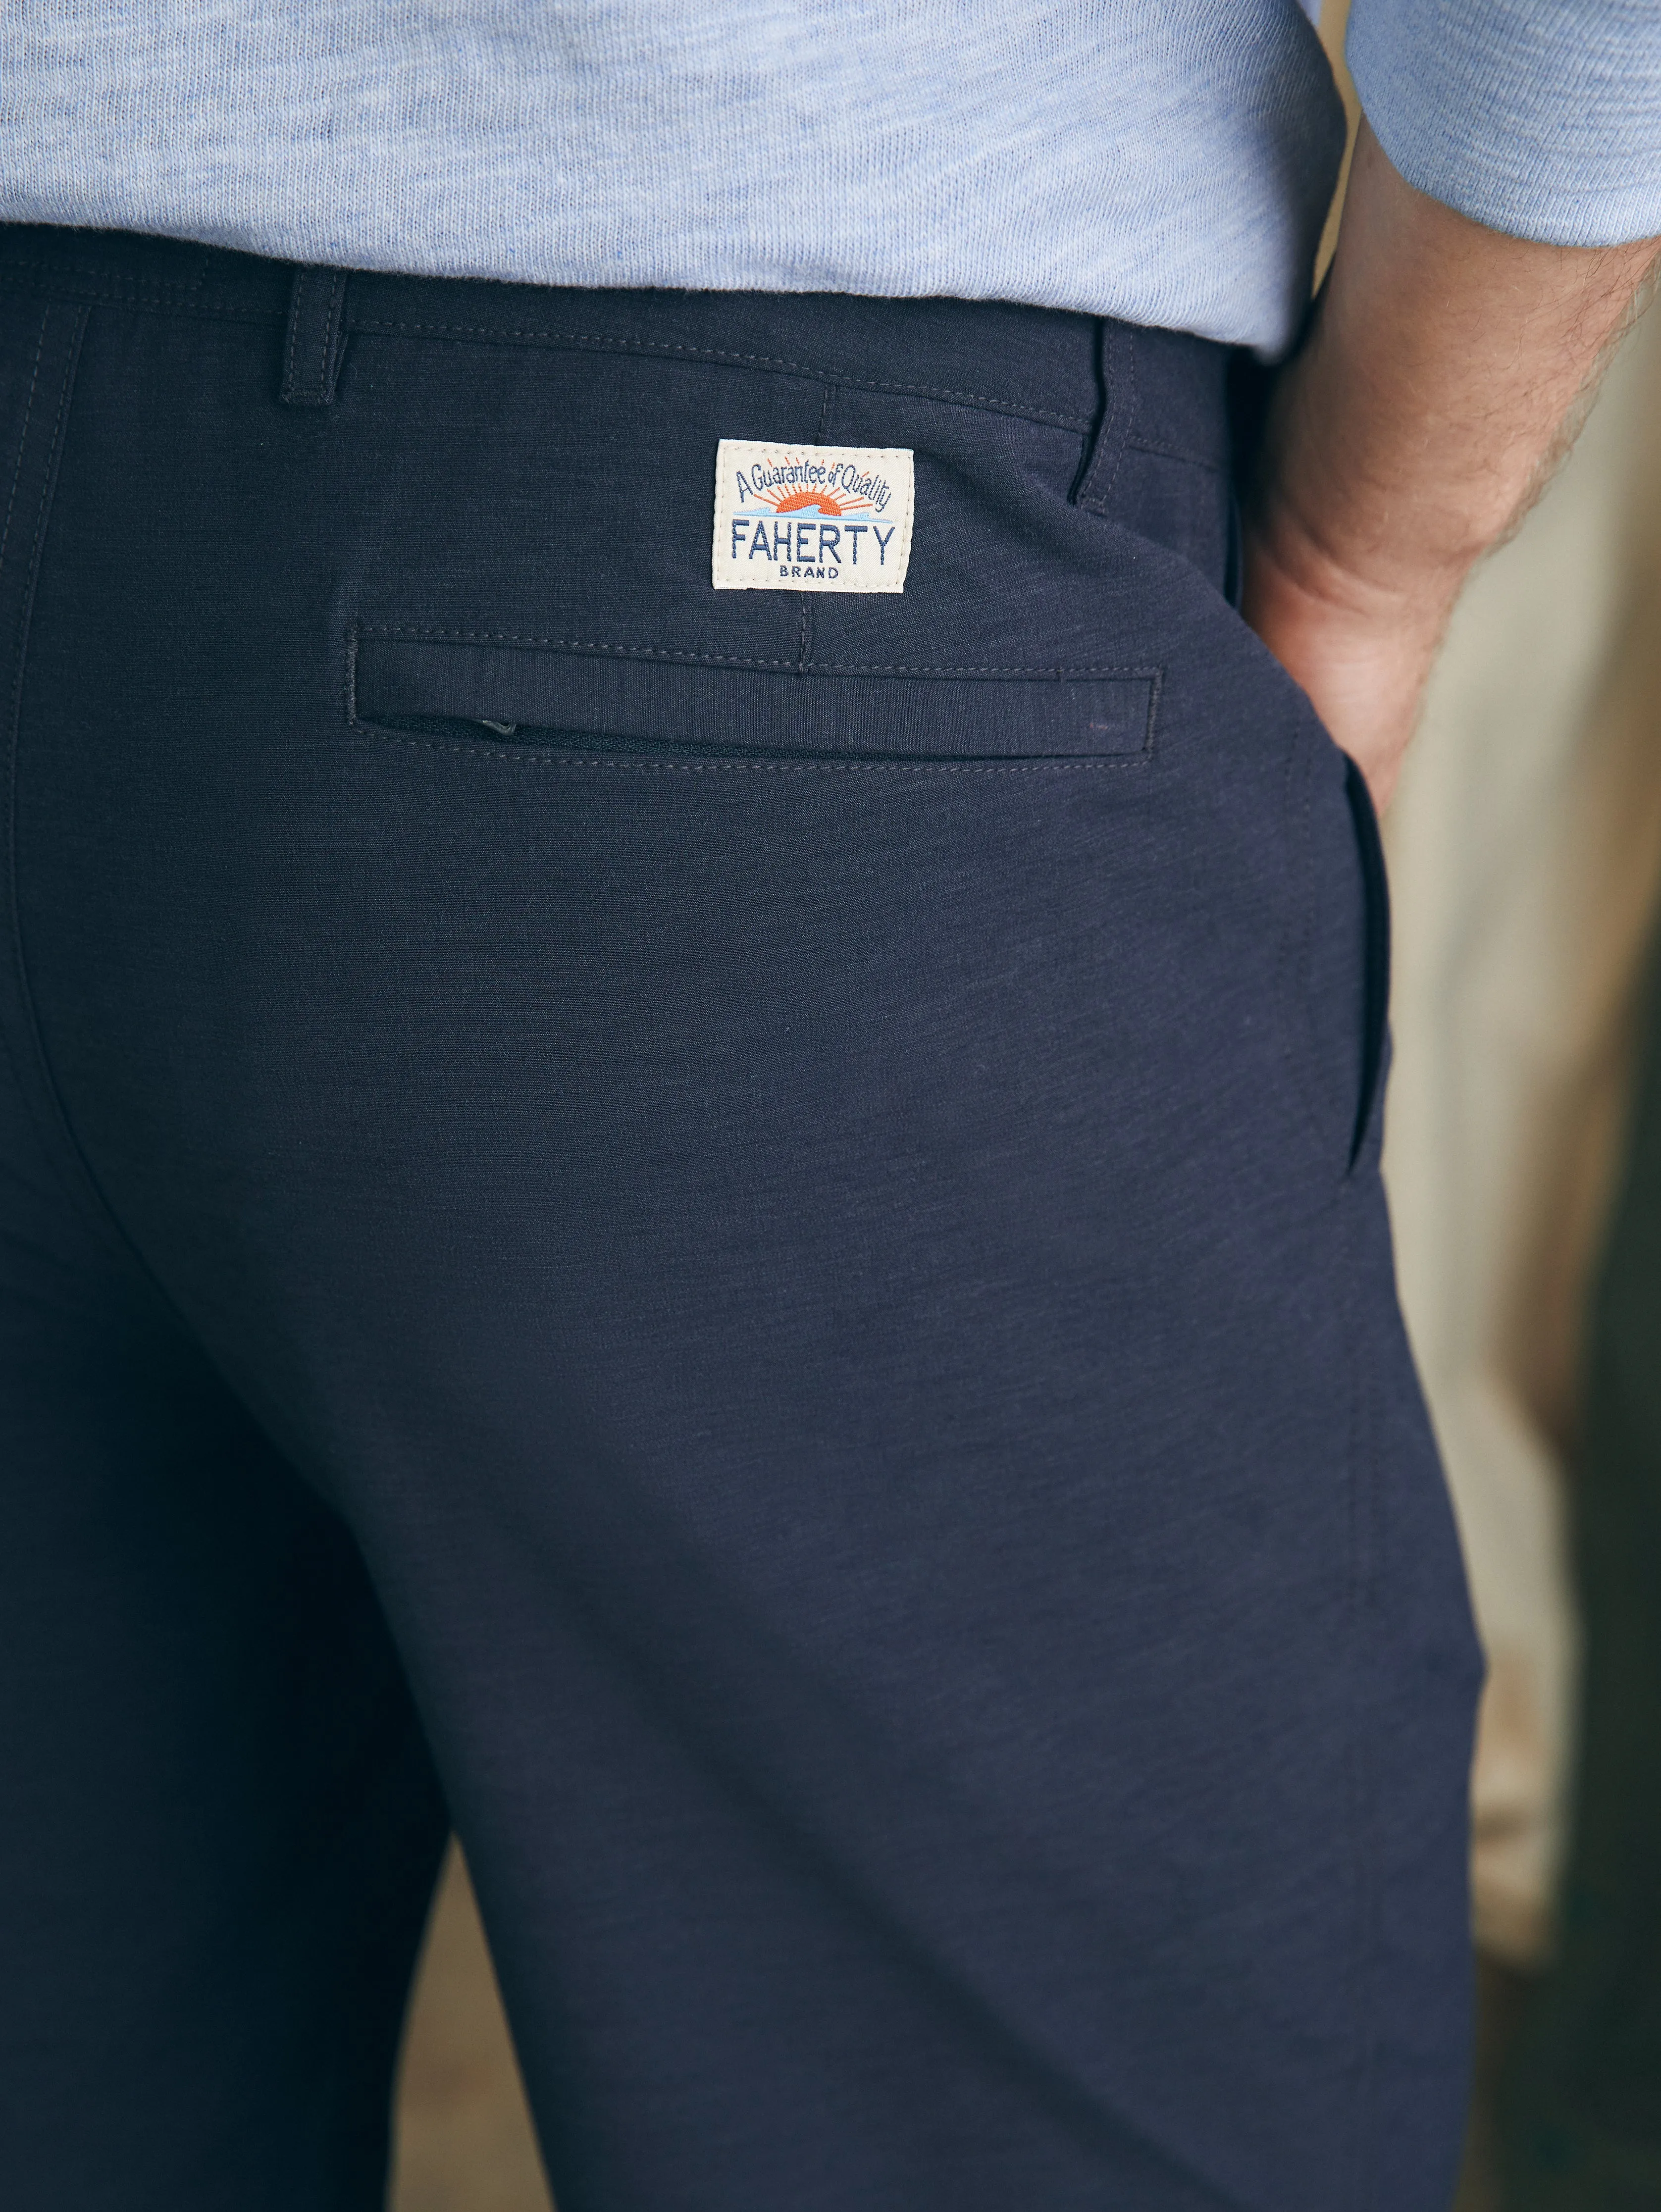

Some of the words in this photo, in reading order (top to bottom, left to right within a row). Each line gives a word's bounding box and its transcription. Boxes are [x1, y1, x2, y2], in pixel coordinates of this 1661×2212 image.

[736, 471, 753, 503] A
[751, 459, 826, 491] Guarantee
[828, 463, 842, 487] of
[842, 464, 892, 513] Quality
[731, 519, 895, 565] FAHERTY
[779, 565, 839, 579] BRAND
